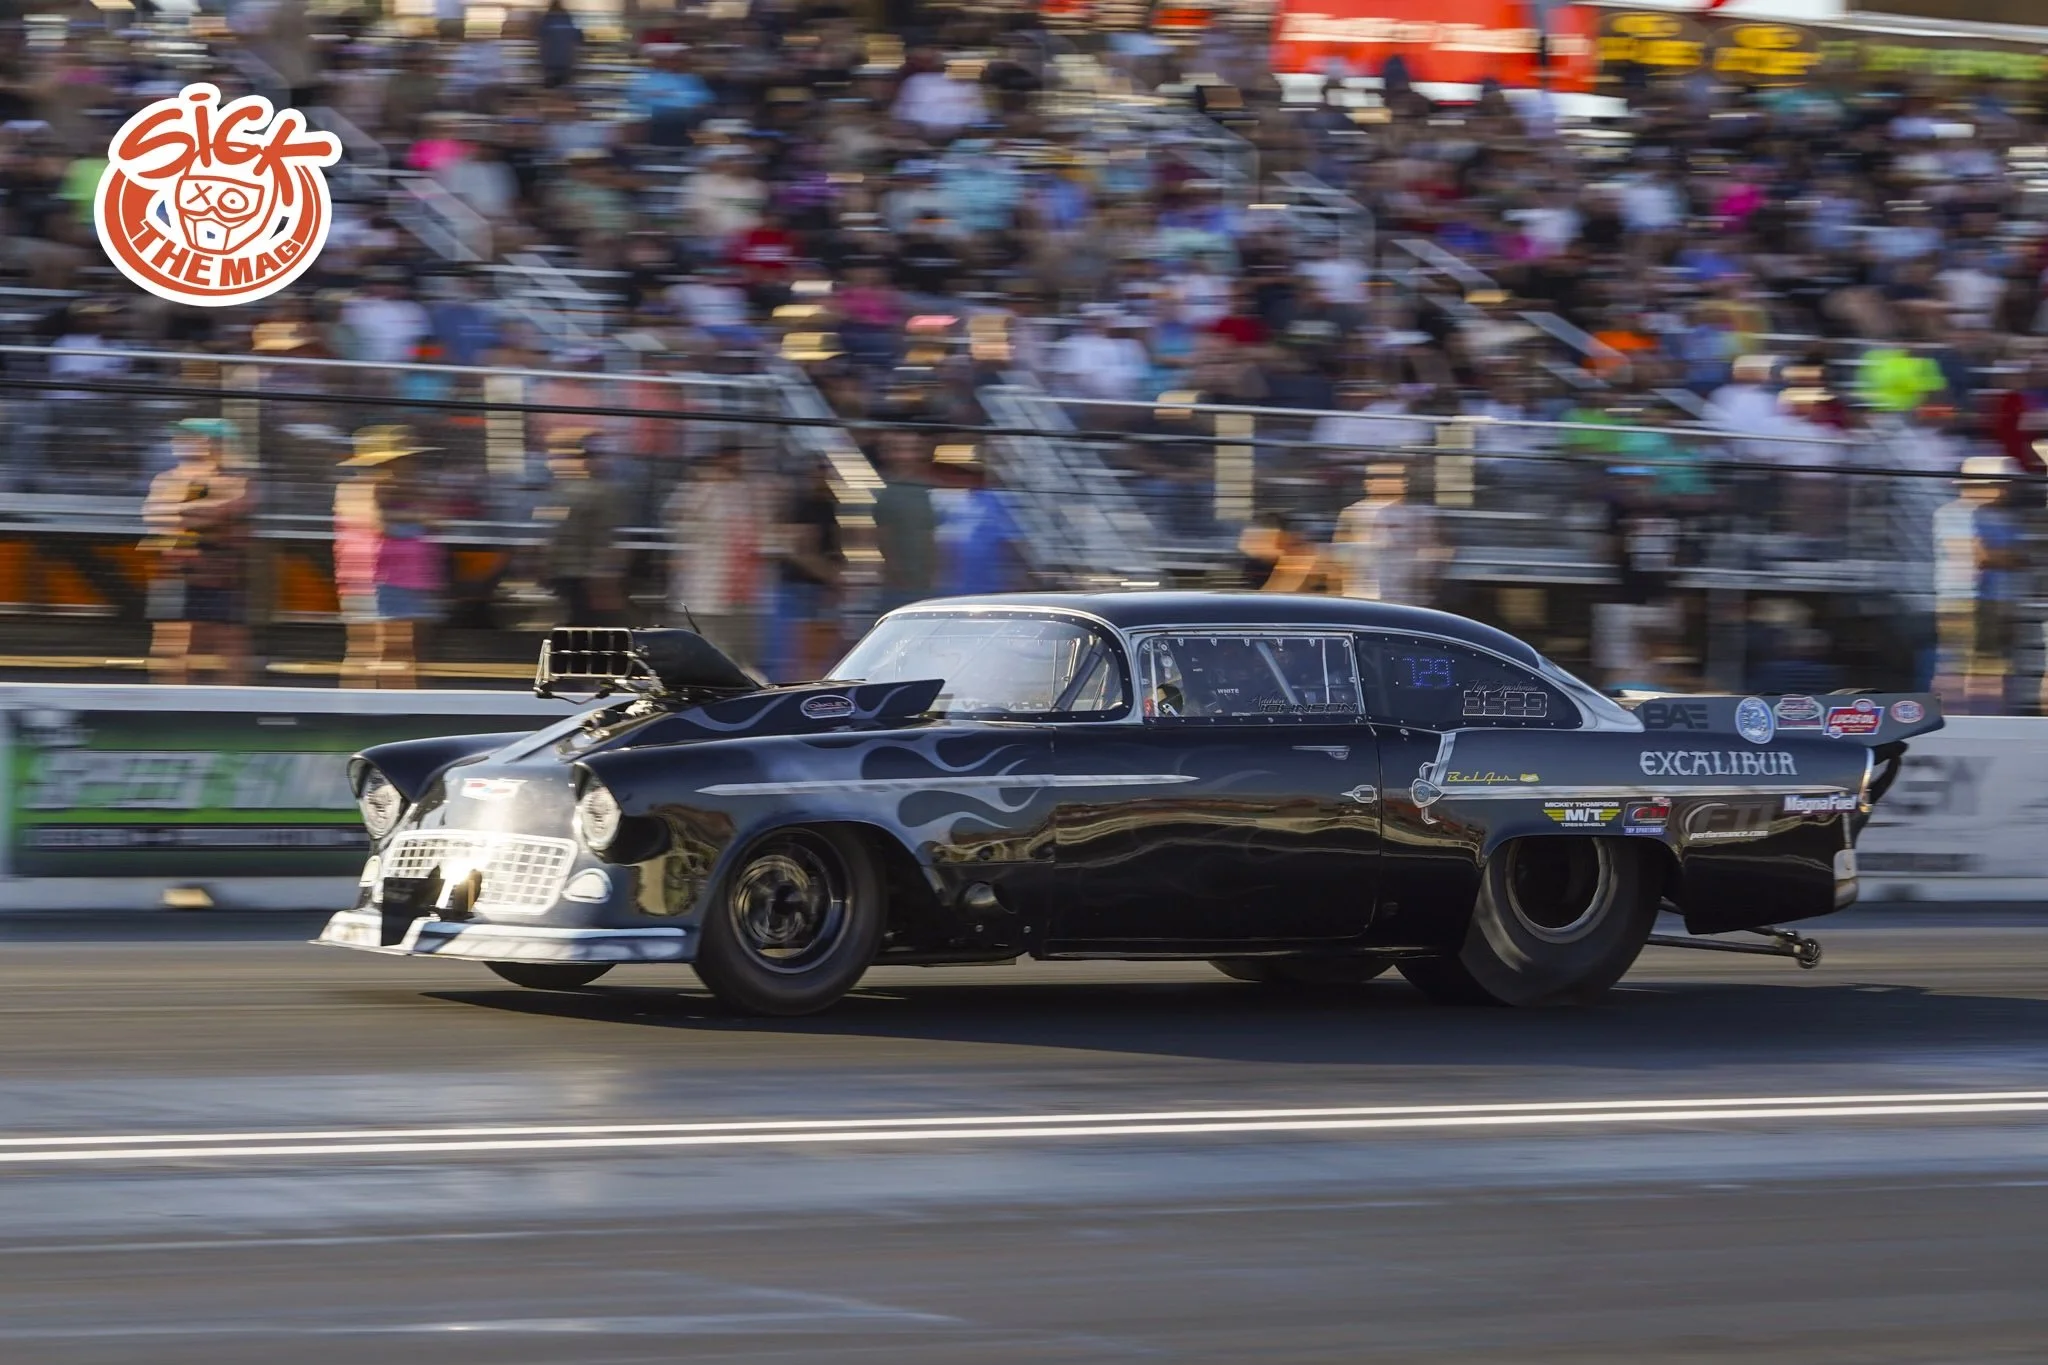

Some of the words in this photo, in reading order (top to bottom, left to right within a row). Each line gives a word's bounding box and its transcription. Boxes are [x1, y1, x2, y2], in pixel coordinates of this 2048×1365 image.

[1643, 703, 1709, 729] BAE
[1639, 750, 1798, 776] EXCALIBUR
[1565, 808, 1603, 822] M/T
[1784, 795, 1858, 814] MagnaFuel
